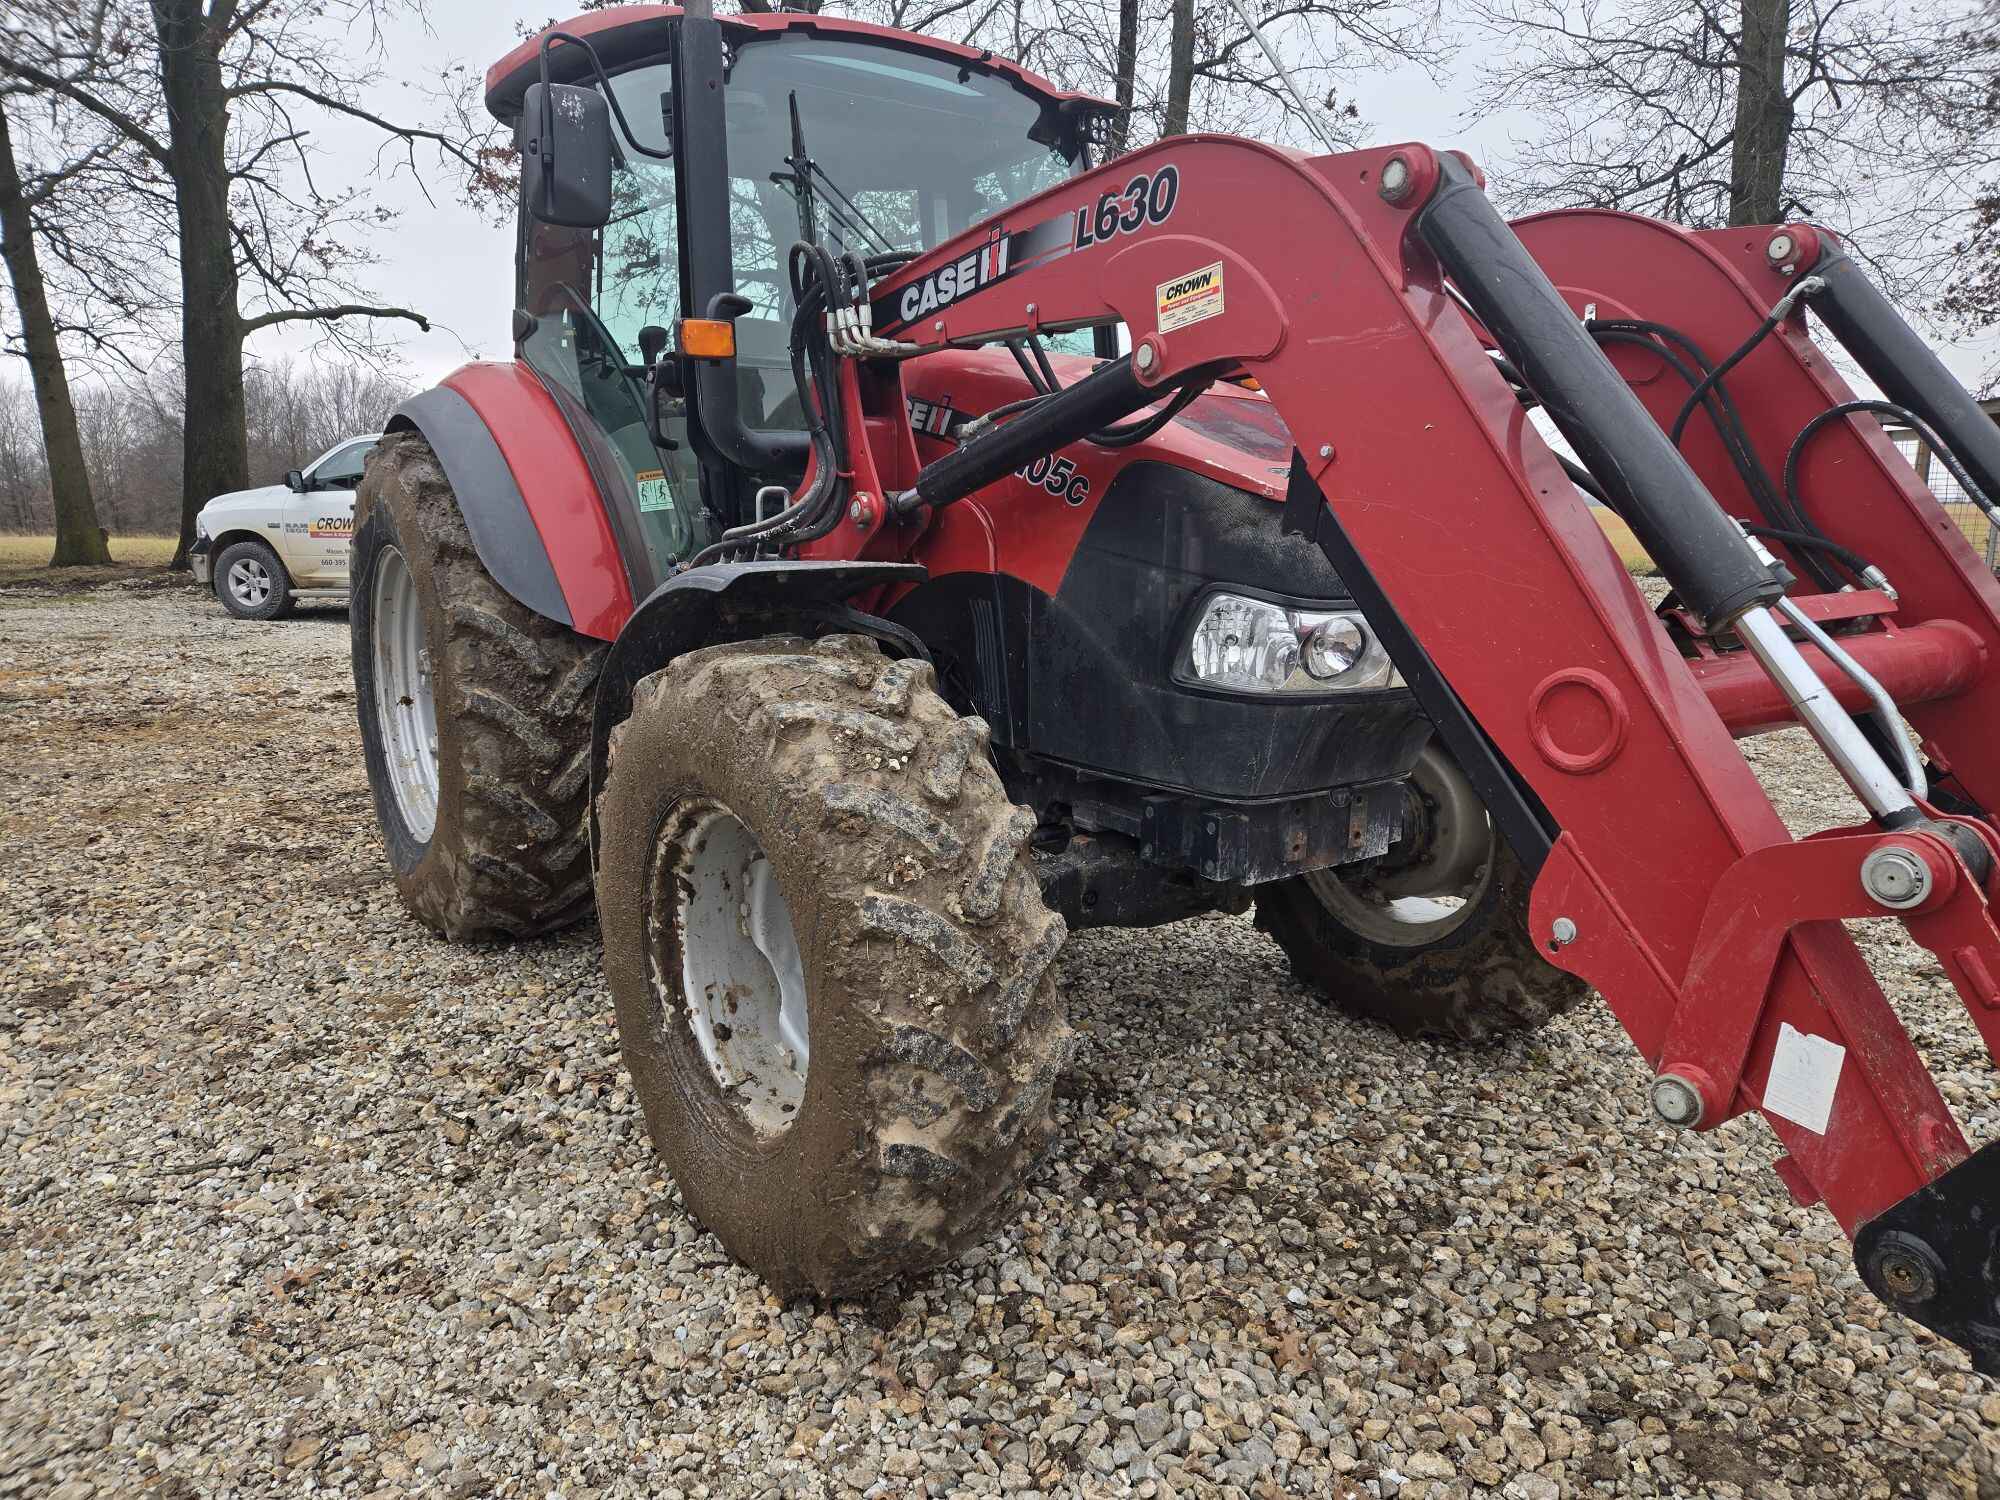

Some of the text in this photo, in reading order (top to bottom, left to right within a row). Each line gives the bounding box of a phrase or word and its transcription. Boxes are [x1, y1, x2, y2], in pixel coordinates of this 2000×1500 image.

[1074, 164, 1180, 252] L630
[900, 254, 978, 323] CASE
[1166, 271, 1212, 300] CROWN
